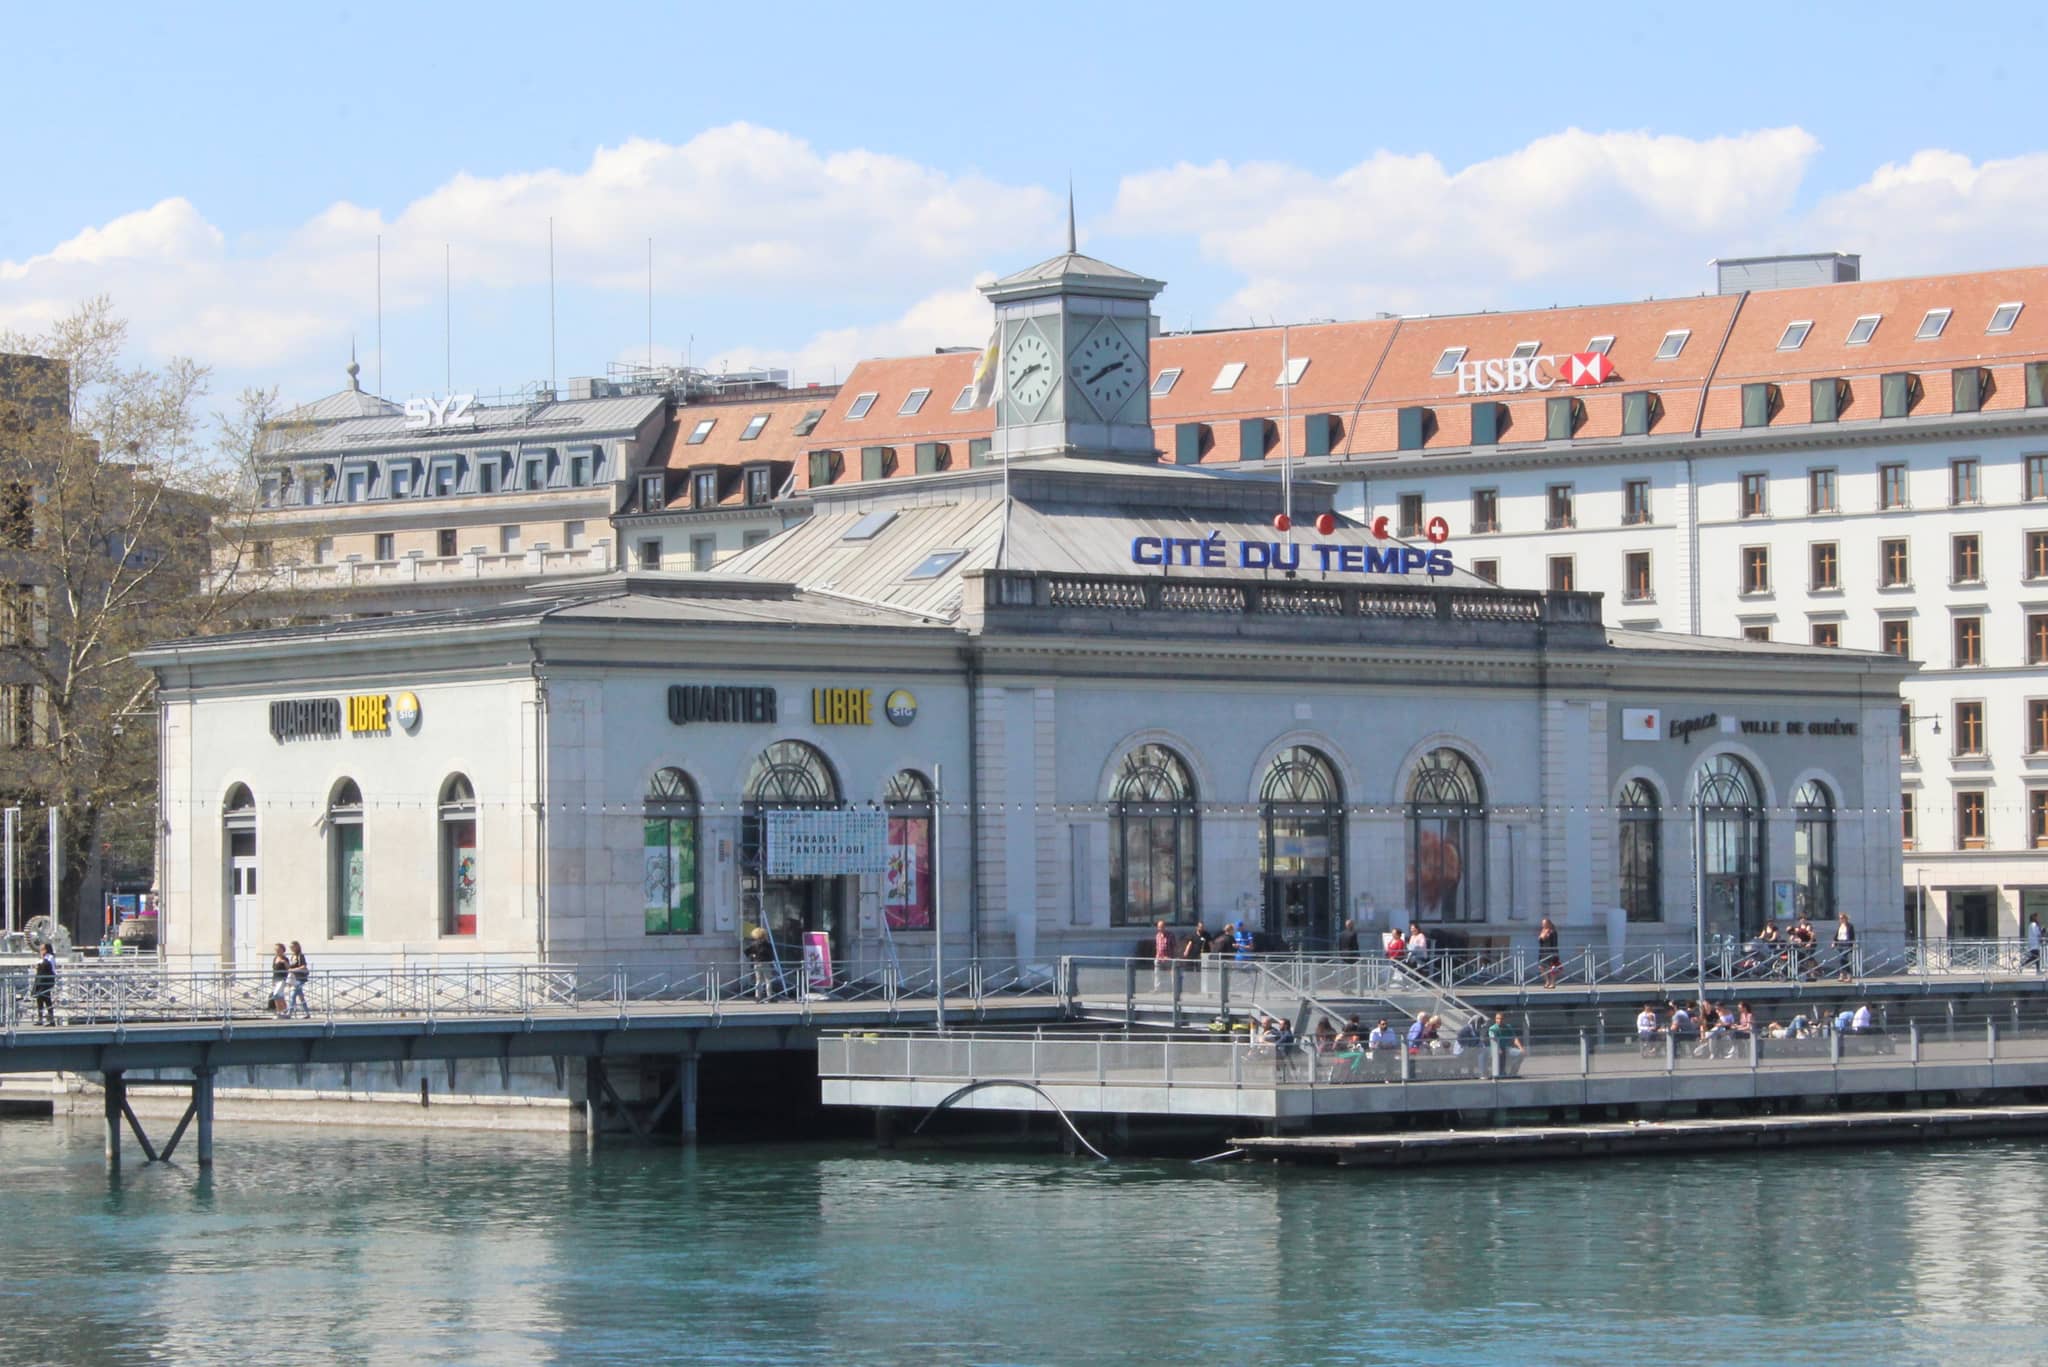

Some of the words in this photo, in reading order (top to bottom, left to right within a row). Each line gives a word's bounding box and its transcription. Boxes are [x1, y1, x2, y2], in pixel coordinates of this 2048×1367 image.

[1456, 355, 1557, 395] HSBC
[404, 394, 475, 429] SYZ
[1132, 530, 1226, 567] CITÉ
[1239, 541, 1300, 569] DU
[1312, 544, 1454, 576] TEMPS
[269, 699, 341, 740] QUARTIER
[346, 694, 391, 732] LIBRE
[668, 685, 777, 725] QUARTIER
[812, 688, 874, 725] LIBRE
[892, 708, 913, 717] SIG
[1669, 712, 1718, 744] Espace
[1740, 720, 1780, 734] VILLE
[1786, 721, 1804, 734] DE
[790, 835, 837, 843] PARADIS
[790, 845, 866, 854] FANTASTIQUE
